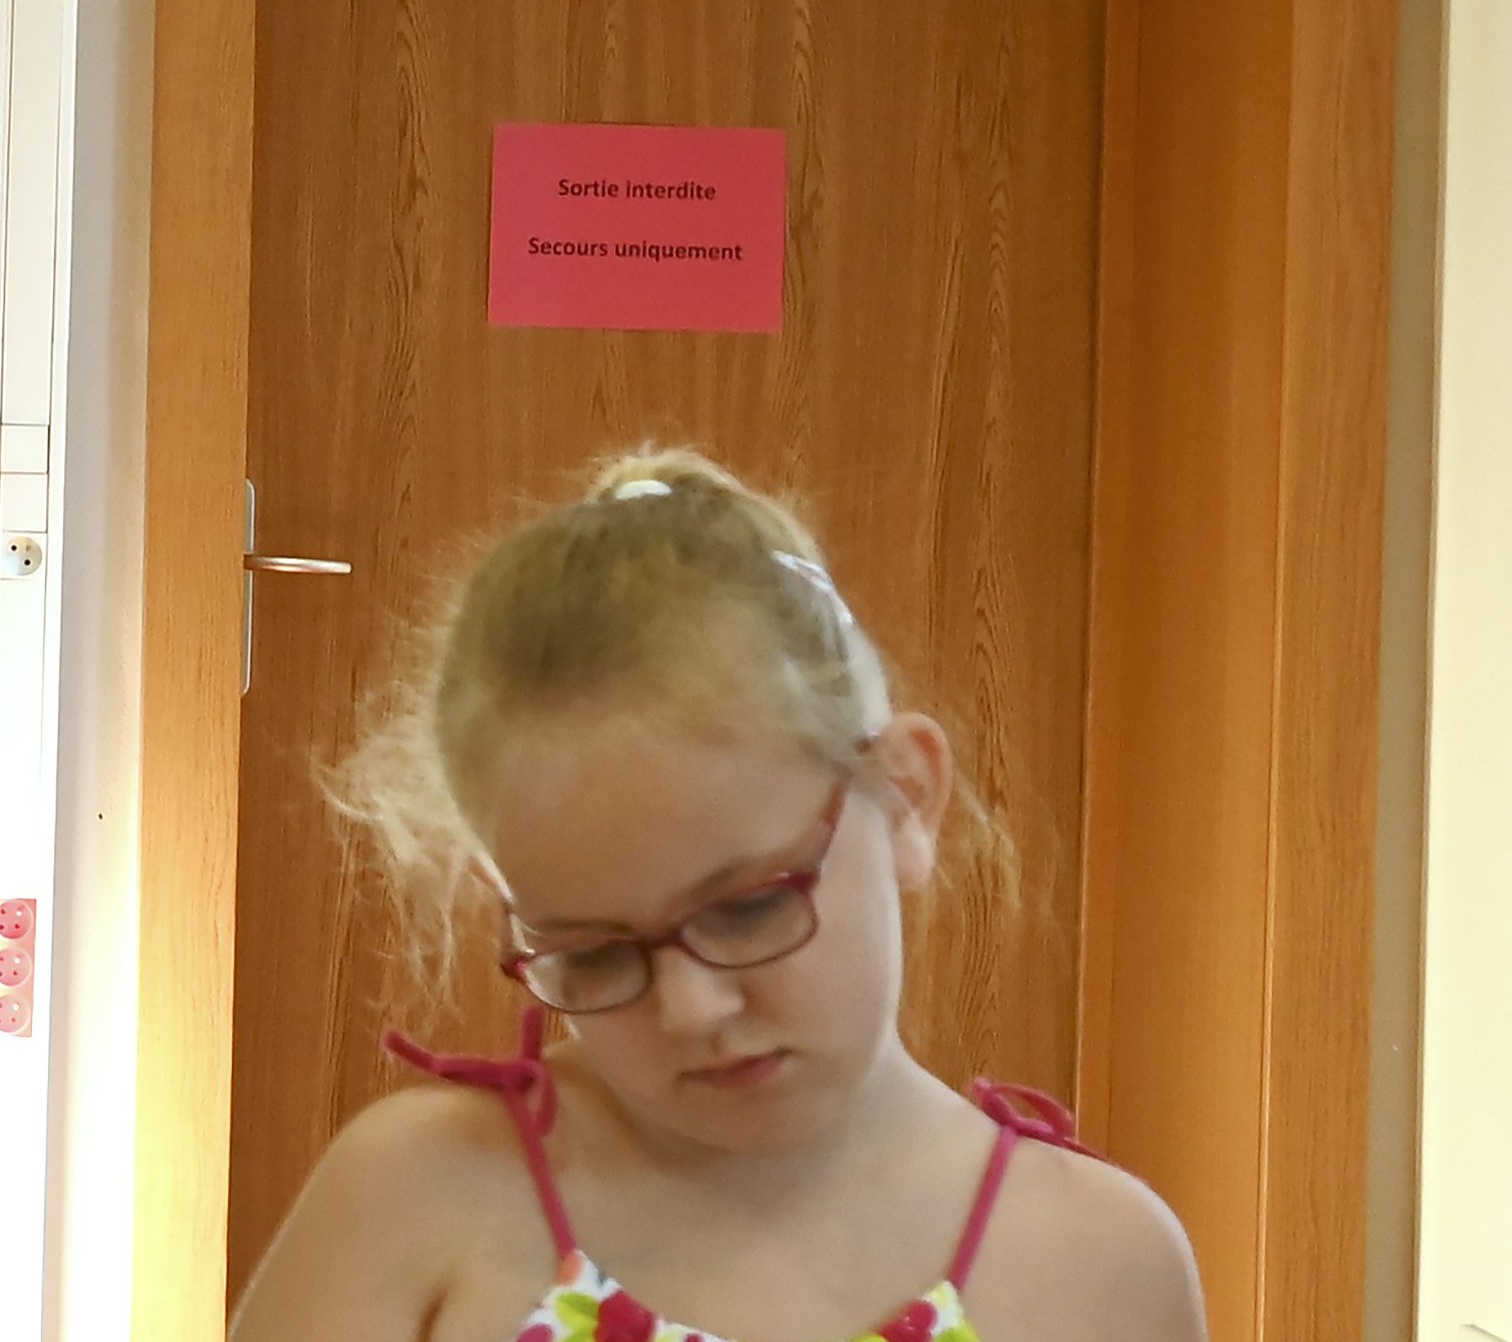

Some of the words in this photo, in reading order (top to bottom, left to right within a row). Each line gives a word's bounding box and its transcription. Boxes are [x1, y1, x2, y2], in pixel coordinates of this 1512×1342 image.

[558, 179, 619, 198] Sortie
[626, 180, 716, 201] interdite
[528, 237, 608, 257] Secours
[615, 240, 743, 262] uniquement
